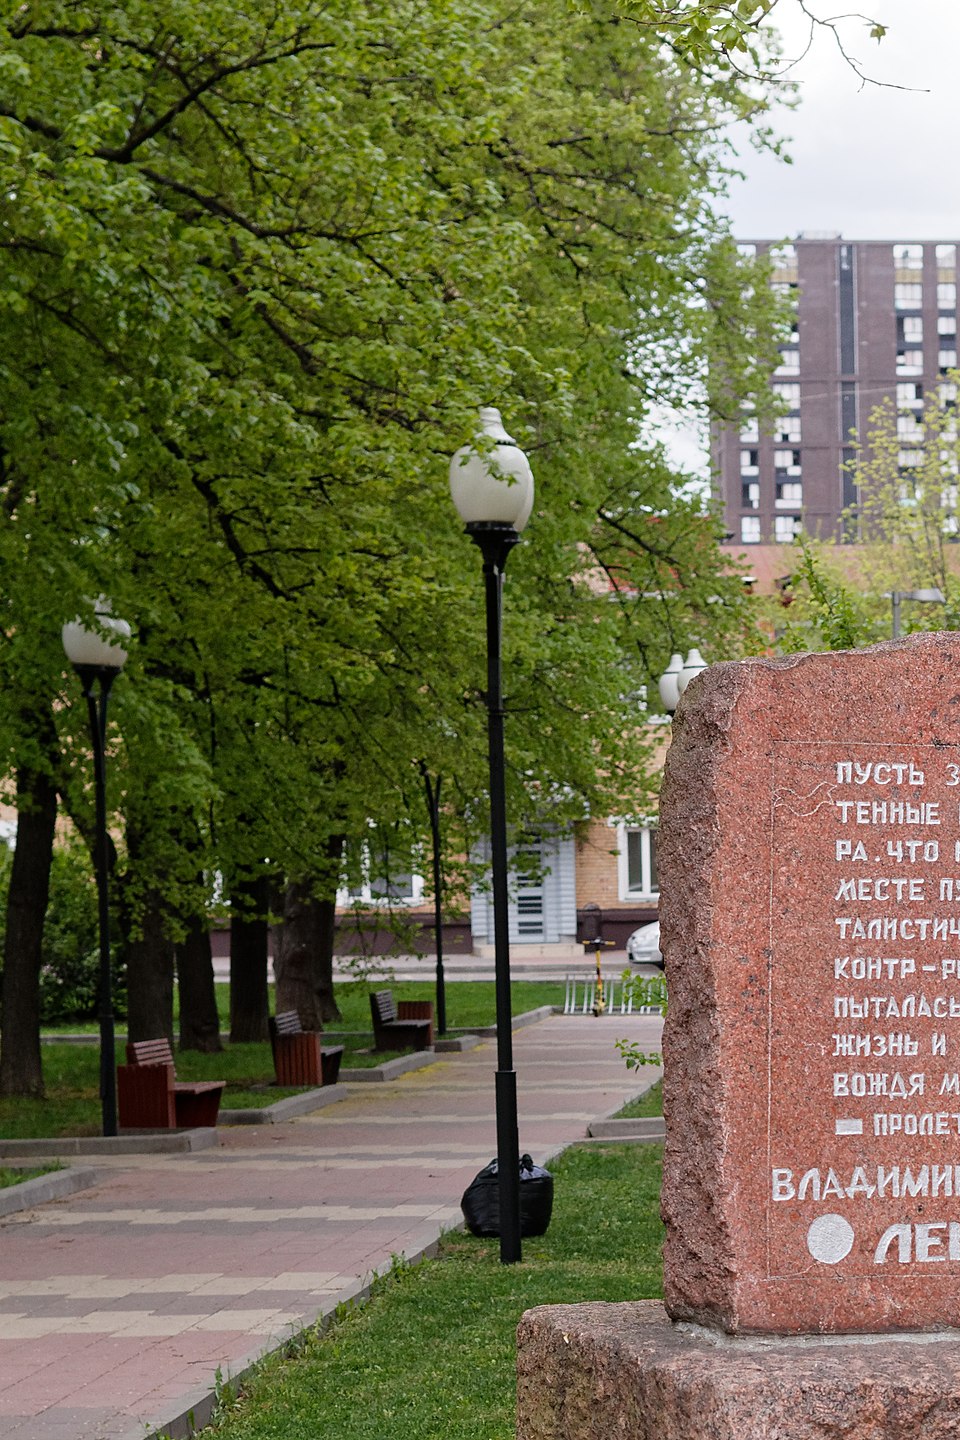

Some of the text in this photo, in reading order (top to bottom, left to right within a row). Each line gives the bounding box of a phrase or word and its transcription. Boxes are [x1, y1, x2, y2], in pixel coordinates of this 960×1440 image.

[836, 761, 925, 785] ПУСТЬ
[836, 801, 941, 824] ТЕННЫЕ
[887, 840, 939, 863] ЧТО
[834, 877, 925, 901] МЕСТЕ
[832, 1033, 919, 1056] ЖИЗНЬ
[932, 1033, 947, 1056] И
[833, 1073, 925, 1099] ВОЖДЯ
